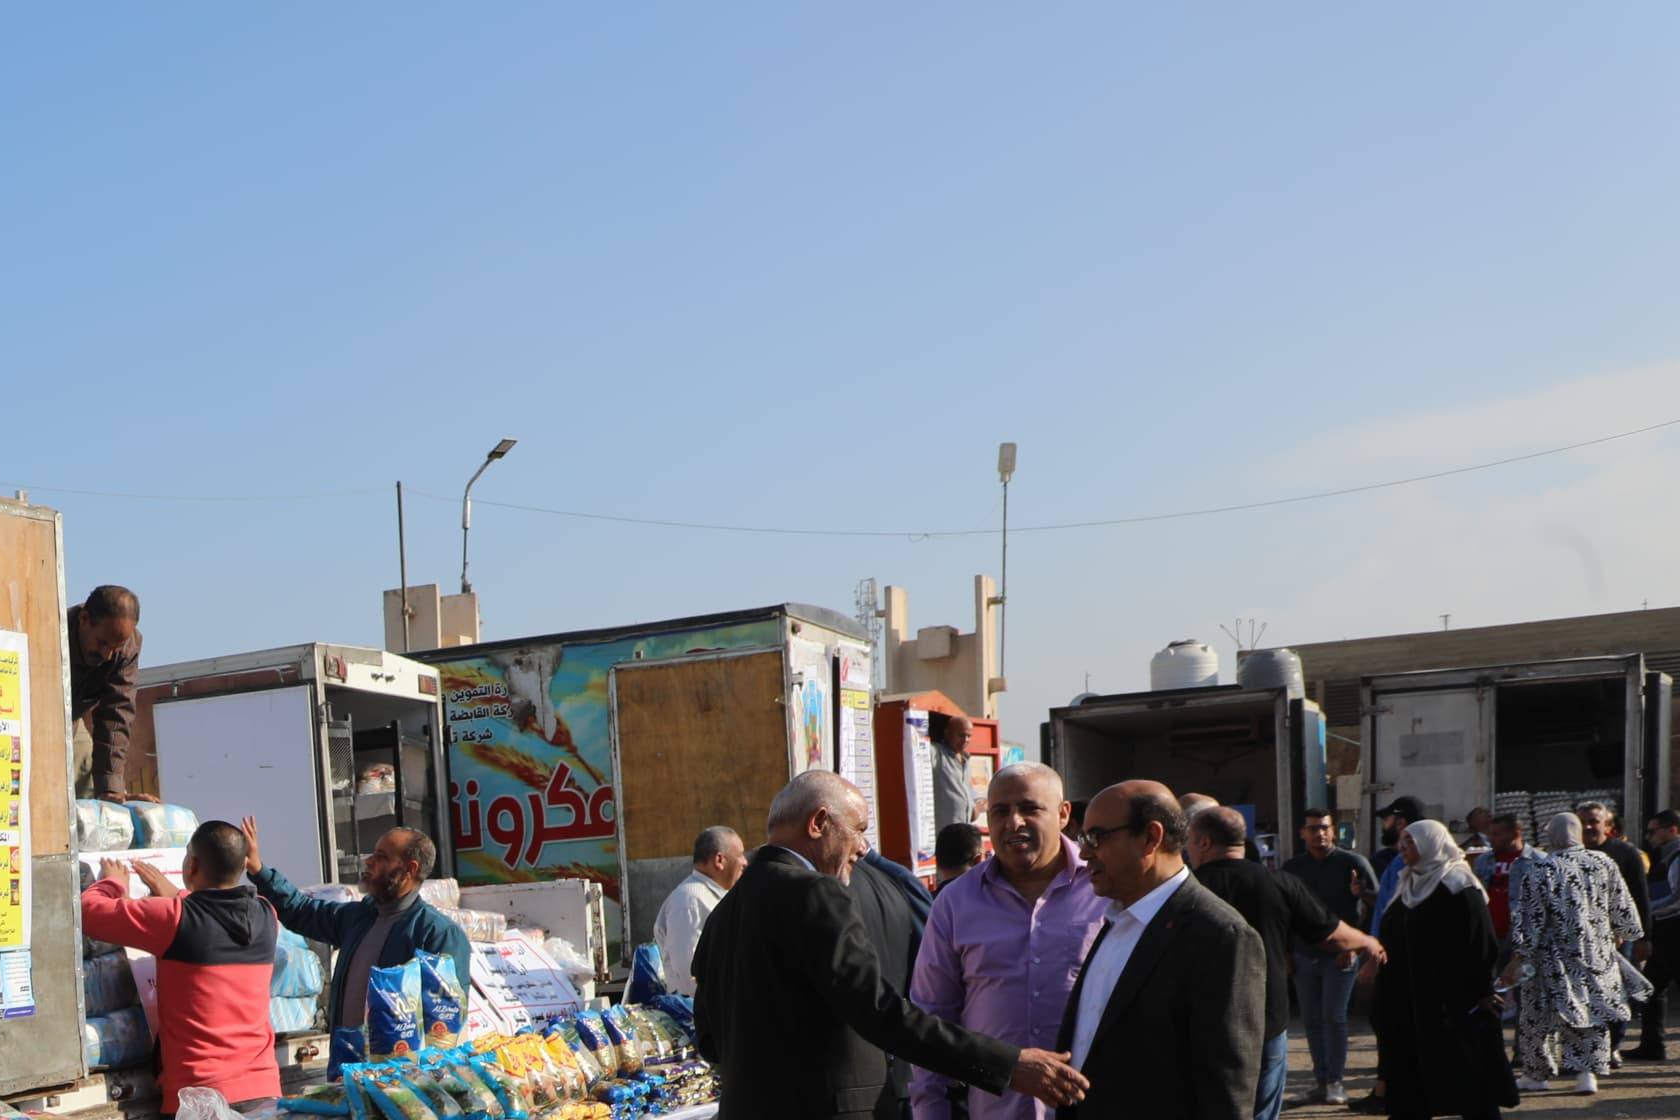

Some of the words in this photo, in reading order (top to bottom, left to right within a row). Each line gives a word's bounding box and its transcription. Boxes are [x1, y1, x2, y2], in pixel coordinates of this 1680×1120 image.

[450, 685, 490, 702] التموين
[450, 706, 490, 722] القابضة
[462, 728, 493, 742] شركة
